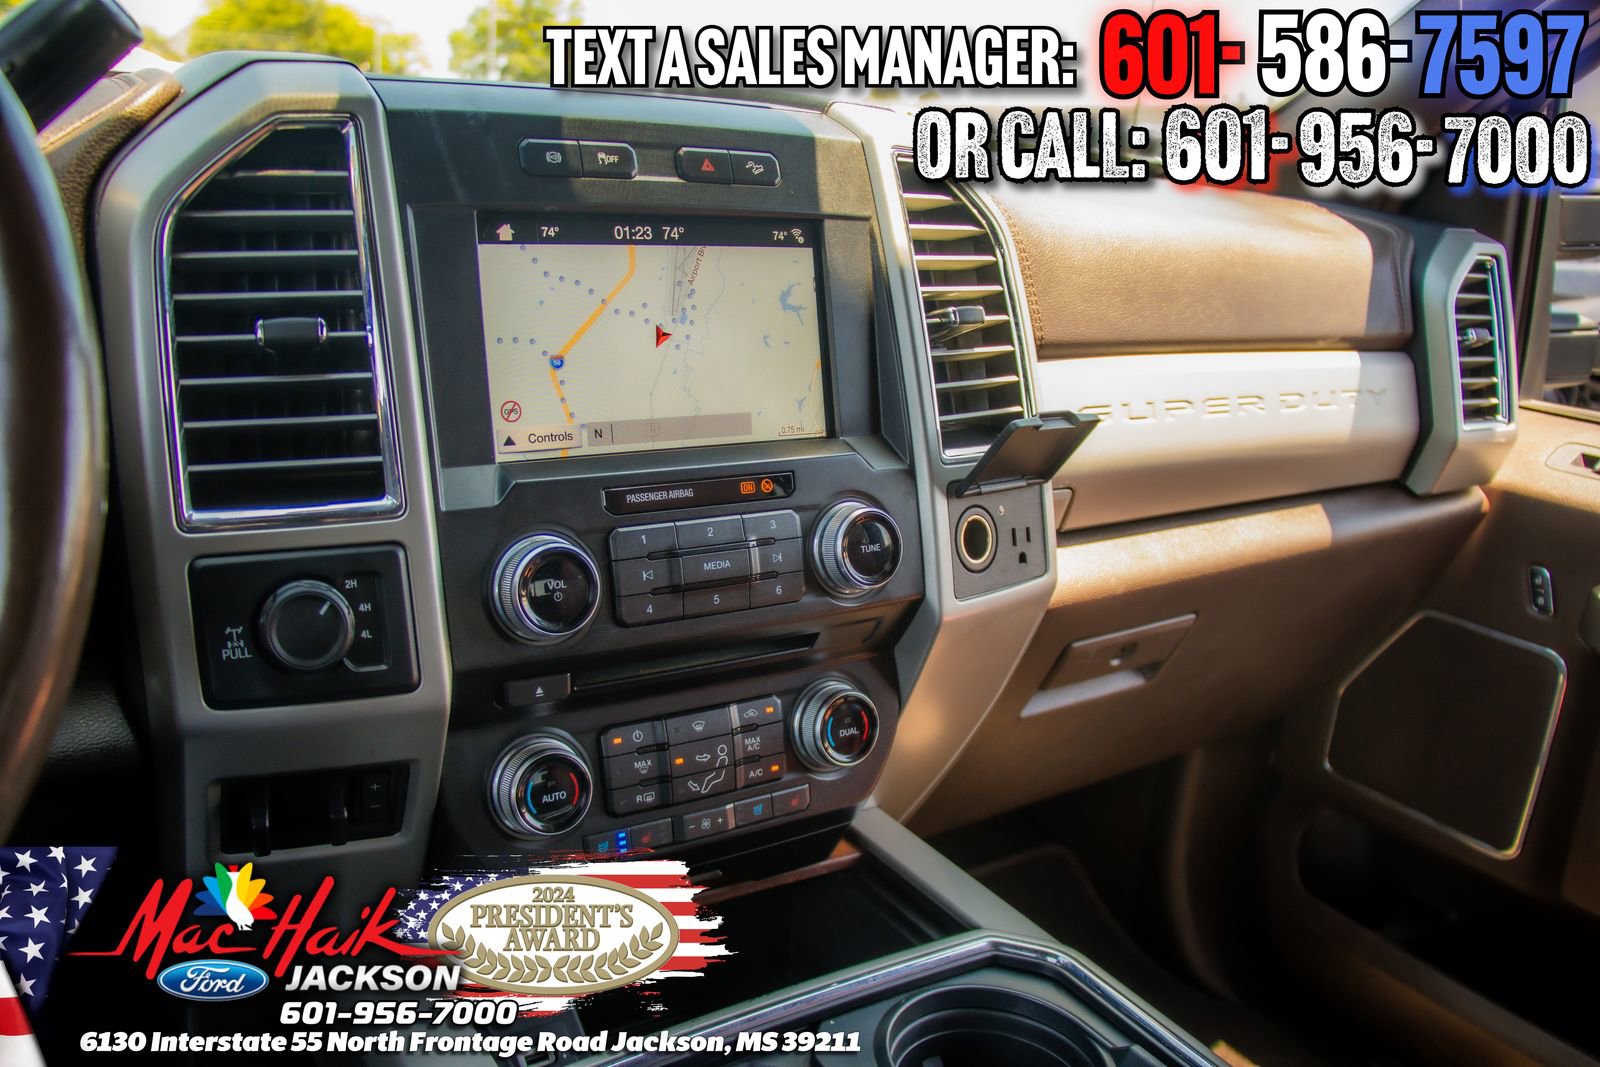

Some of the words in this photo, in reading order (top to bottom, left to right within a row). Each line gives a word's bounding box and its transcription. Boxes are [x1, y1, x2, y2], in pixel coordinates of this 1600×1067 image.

[606, 155, 619, 164] OFF
[541, 226, 559, 238] 74°
[614, 226, 652, 240] 01:23
[662, 226, 685, 240] 74°
[772, 231, 787, 241] 74°
[687, 257, 702, 287] Airport
[1076, 395, 1265, 424] SUPER
[1279, 388, 1386, 412] DUTY
[594, 429, 603, 439] N
[781, 425, 795, 434] 0.75
[528, 431, 573, 444] Controls
[743, 484, 754, 492] ON
[626, 490, 668, 503] PASSENGER
[668, 487, 694, 500] AIRBAG
[769, 520, 777, 530] 3
[707, 527, 714, 537] 2
[640, 534, 647, 544] 1
[860, 543, 881, 553] TUNE
[703, 559, 731, 570] MEDIA
[345, 579, 358, 589] 2H
[547, 580, 567, 590] VOL
[776, 585, 783, 595] 6
[713, 595, 720, 605] 5
[359, 603, 371, 612] 4H
[645, 605, 653, 615] 4
[361, 630, 372, 639] 4L
[222, 646, 252, 660] PULL
[839, 727, 860, 737] DUAL
[744, 736, 761, 745] MAX
[747, 743, 760, 752] A/C
[634, 760, 652, 769] MAX
[749, 768, 764, 778] A/C
[542, 790, 567, 803] AUTO
